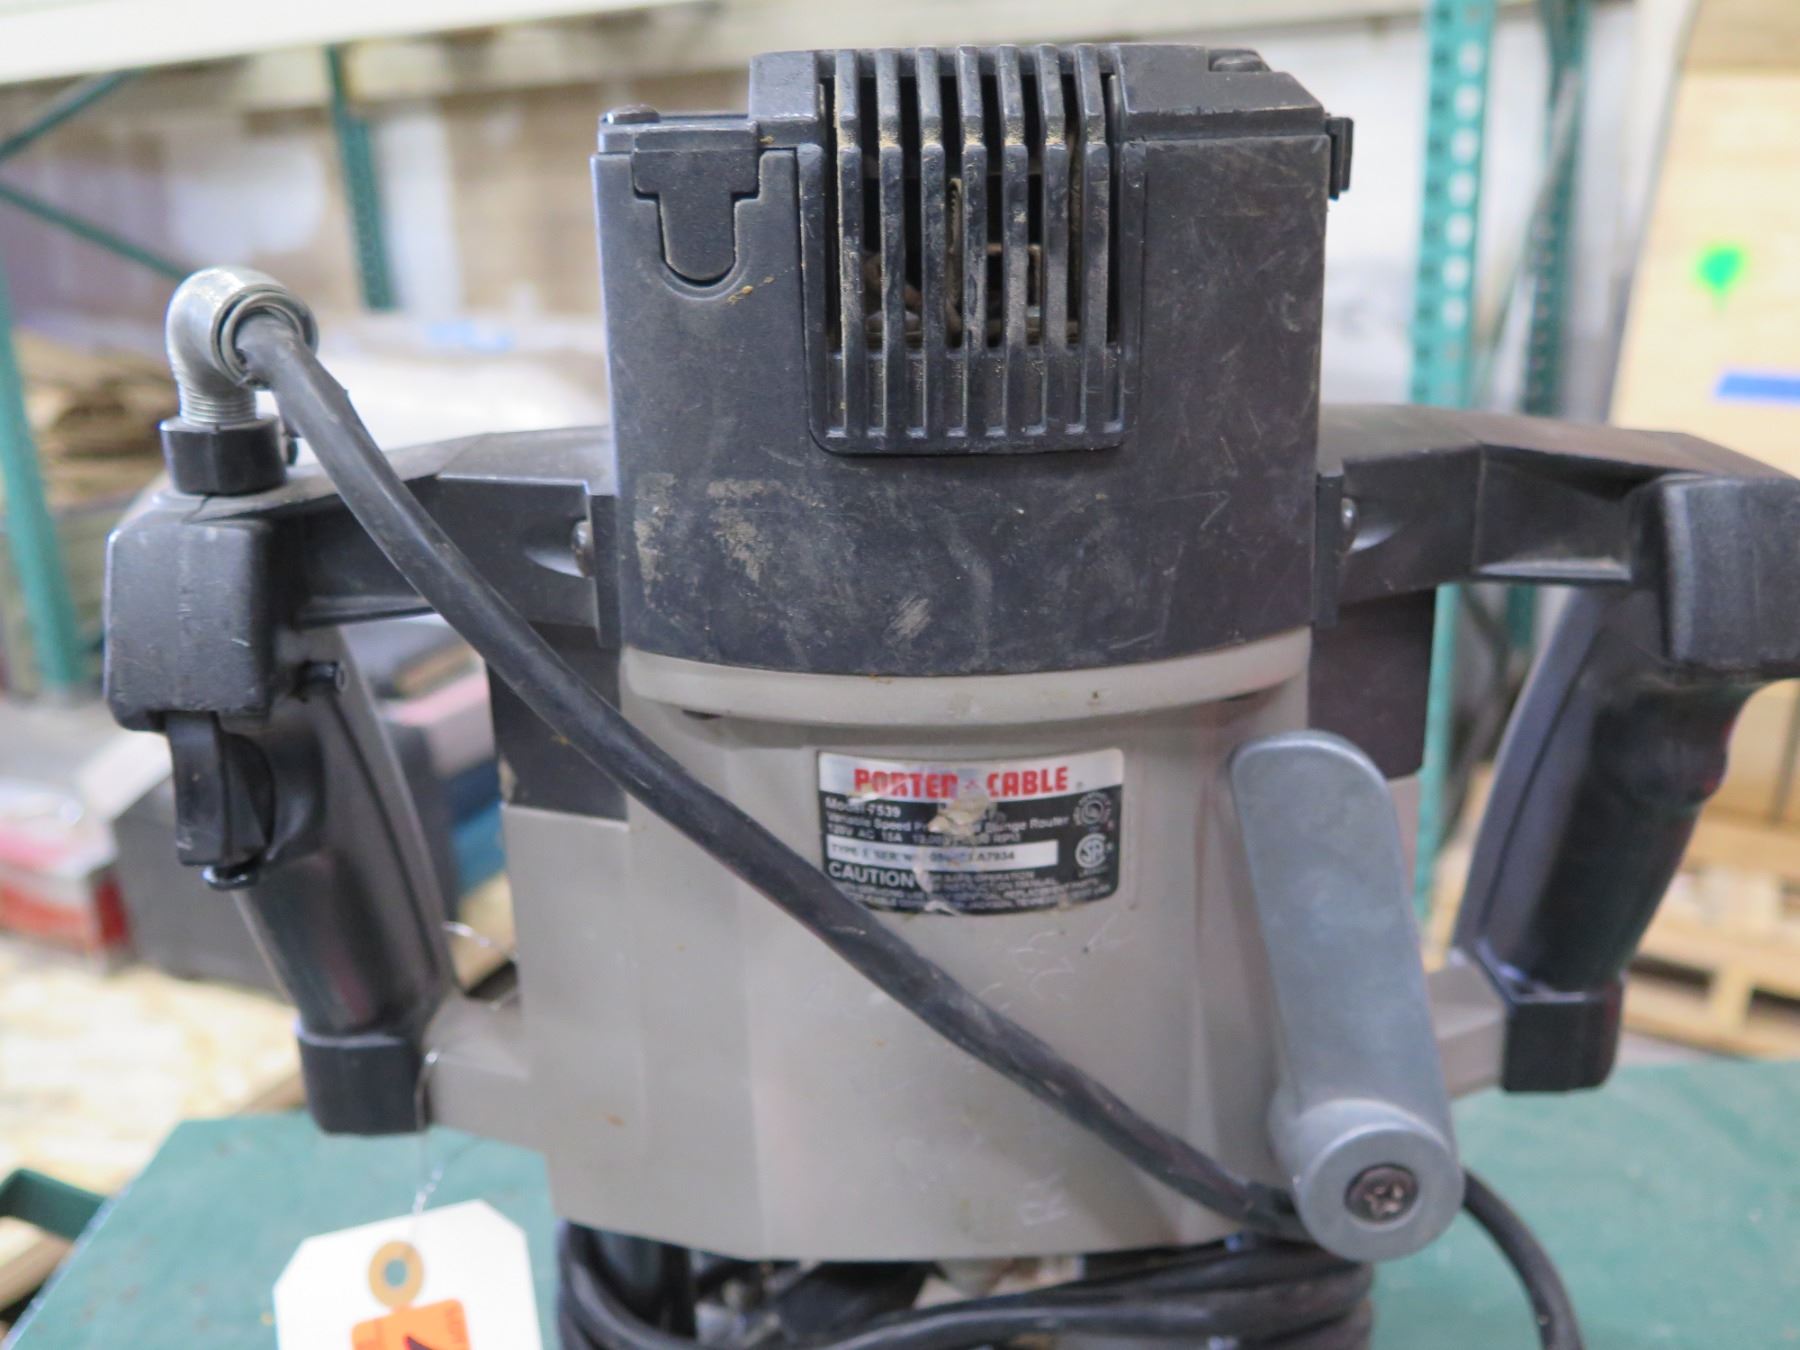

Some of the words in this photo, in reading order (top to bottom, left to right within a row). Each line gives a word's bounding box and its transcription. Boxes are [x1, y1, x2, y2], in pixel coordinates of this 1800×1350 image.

[986, 765, 1068, 798] CABLE
[873, 818, 912, 831] Speed
[1029, 816, 1069, 829] Router
[828, 862, 916, 889] CAUTION
